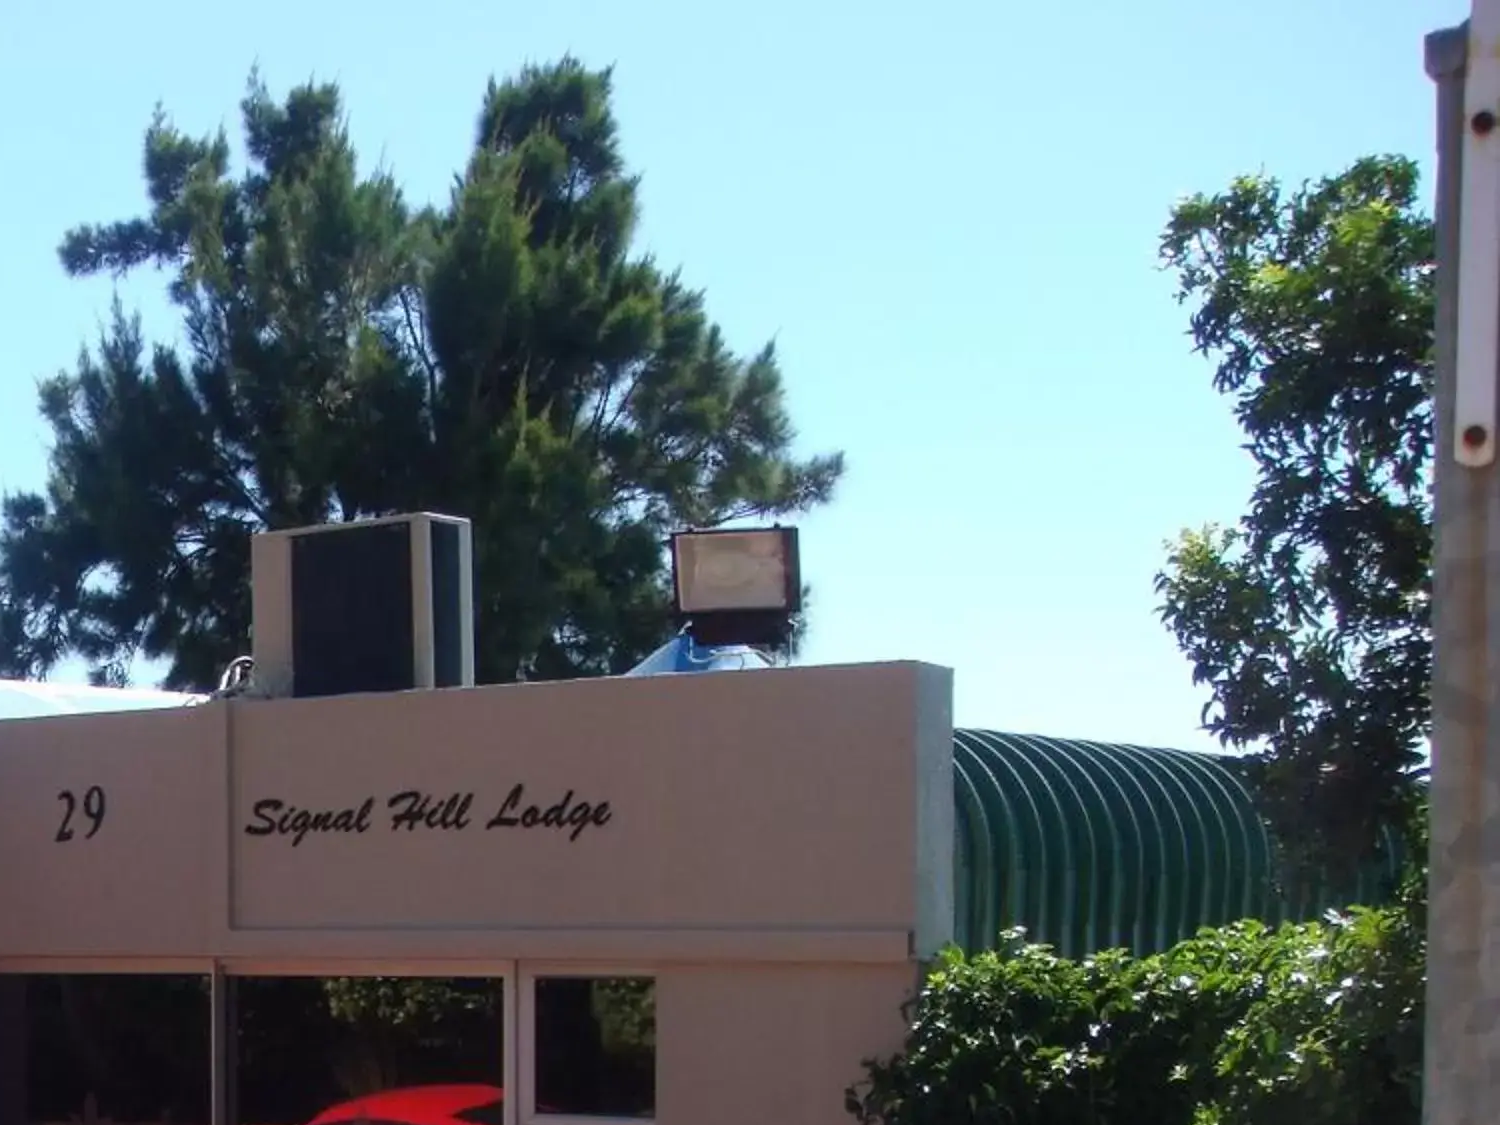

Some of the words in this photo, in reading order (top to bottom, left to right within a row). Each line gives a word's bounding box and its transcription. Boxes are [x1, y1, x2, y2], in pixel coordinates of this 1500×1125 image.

[54, 785, 106, 842] 29
[244, 796, 375, 847] Signal
[387, 791, 474, 832] Hill
[485, 783, 612, 842] Lodge
